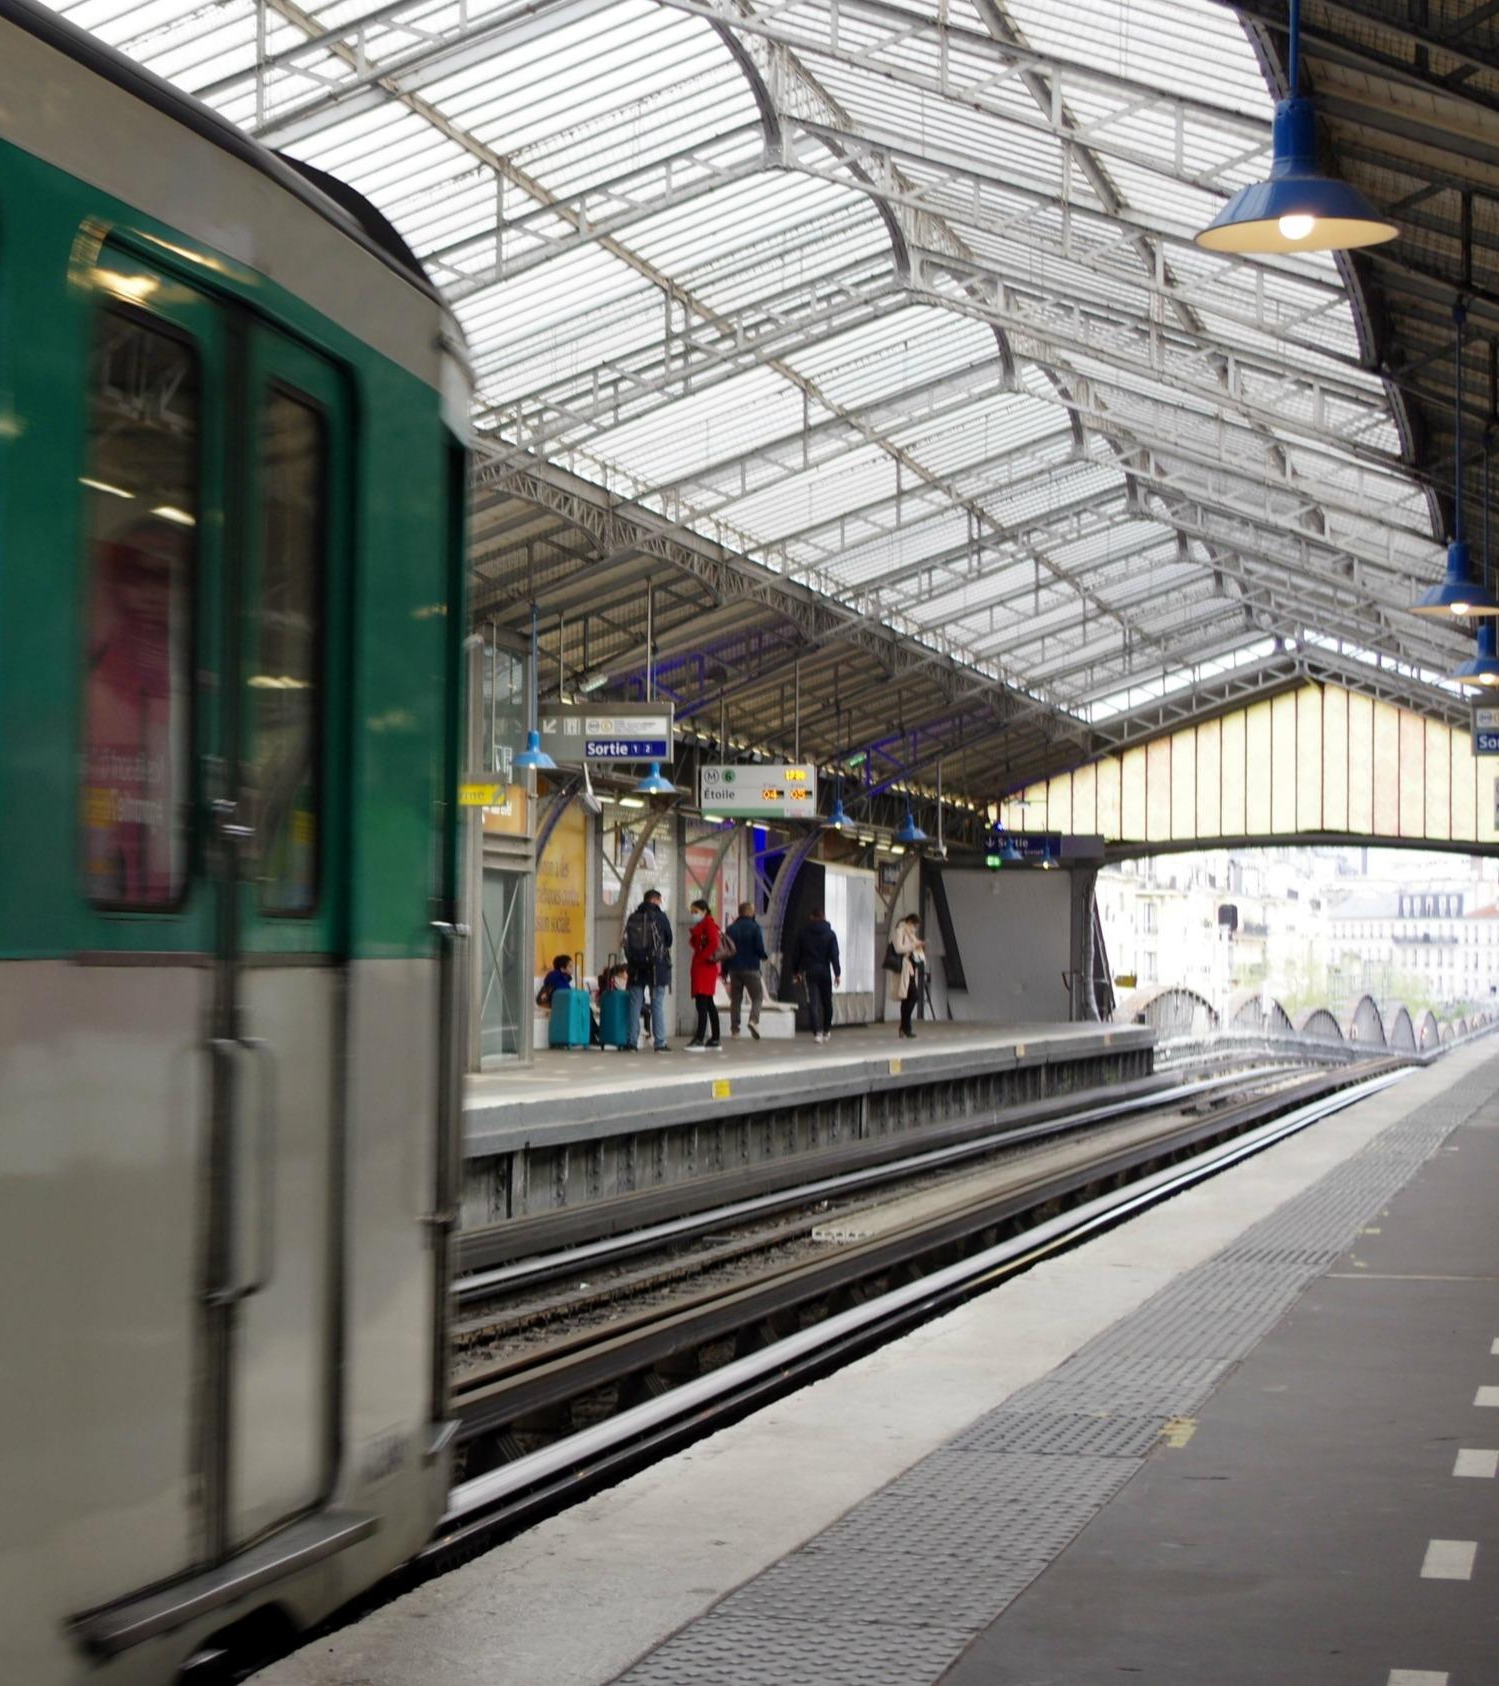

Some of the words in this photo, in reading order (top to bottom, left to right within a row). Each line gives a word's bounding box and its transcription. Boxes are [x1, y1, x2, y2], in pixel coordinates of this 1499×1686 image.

[587, 742, 629, 756] Sortie
[633, 744, 639, 754] 1
[645, 744, 651, 754] 2
[704, 788, 735, 800] Étoile
